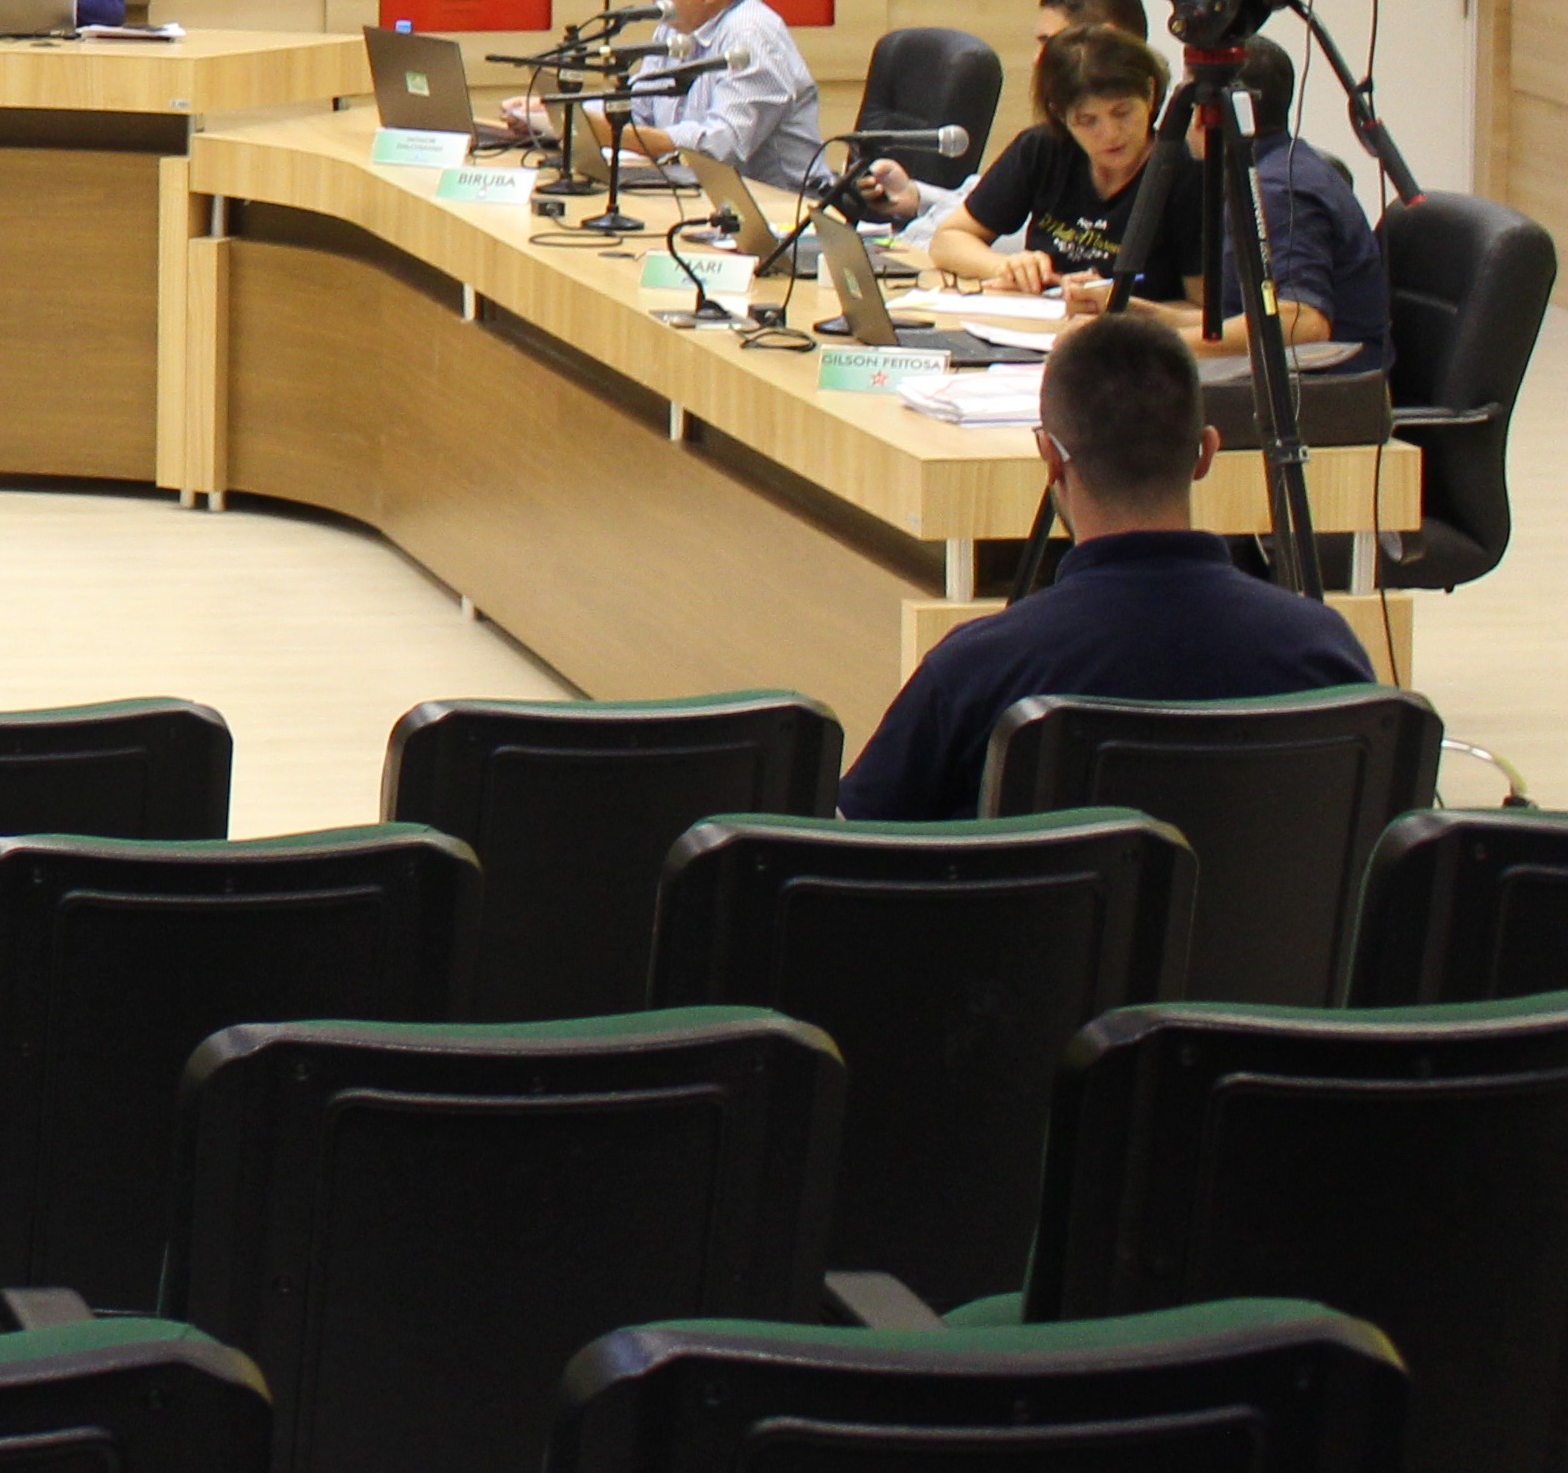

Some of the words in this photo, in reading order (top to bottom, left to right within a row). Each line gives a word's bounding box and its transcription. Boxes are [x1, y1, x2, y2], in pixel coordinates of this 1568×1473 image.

[458, 172, 516, 187] BIRUBA
[822, 354, 878, 367] GILSON
[883, 357, 941, 371] FEITOSA
